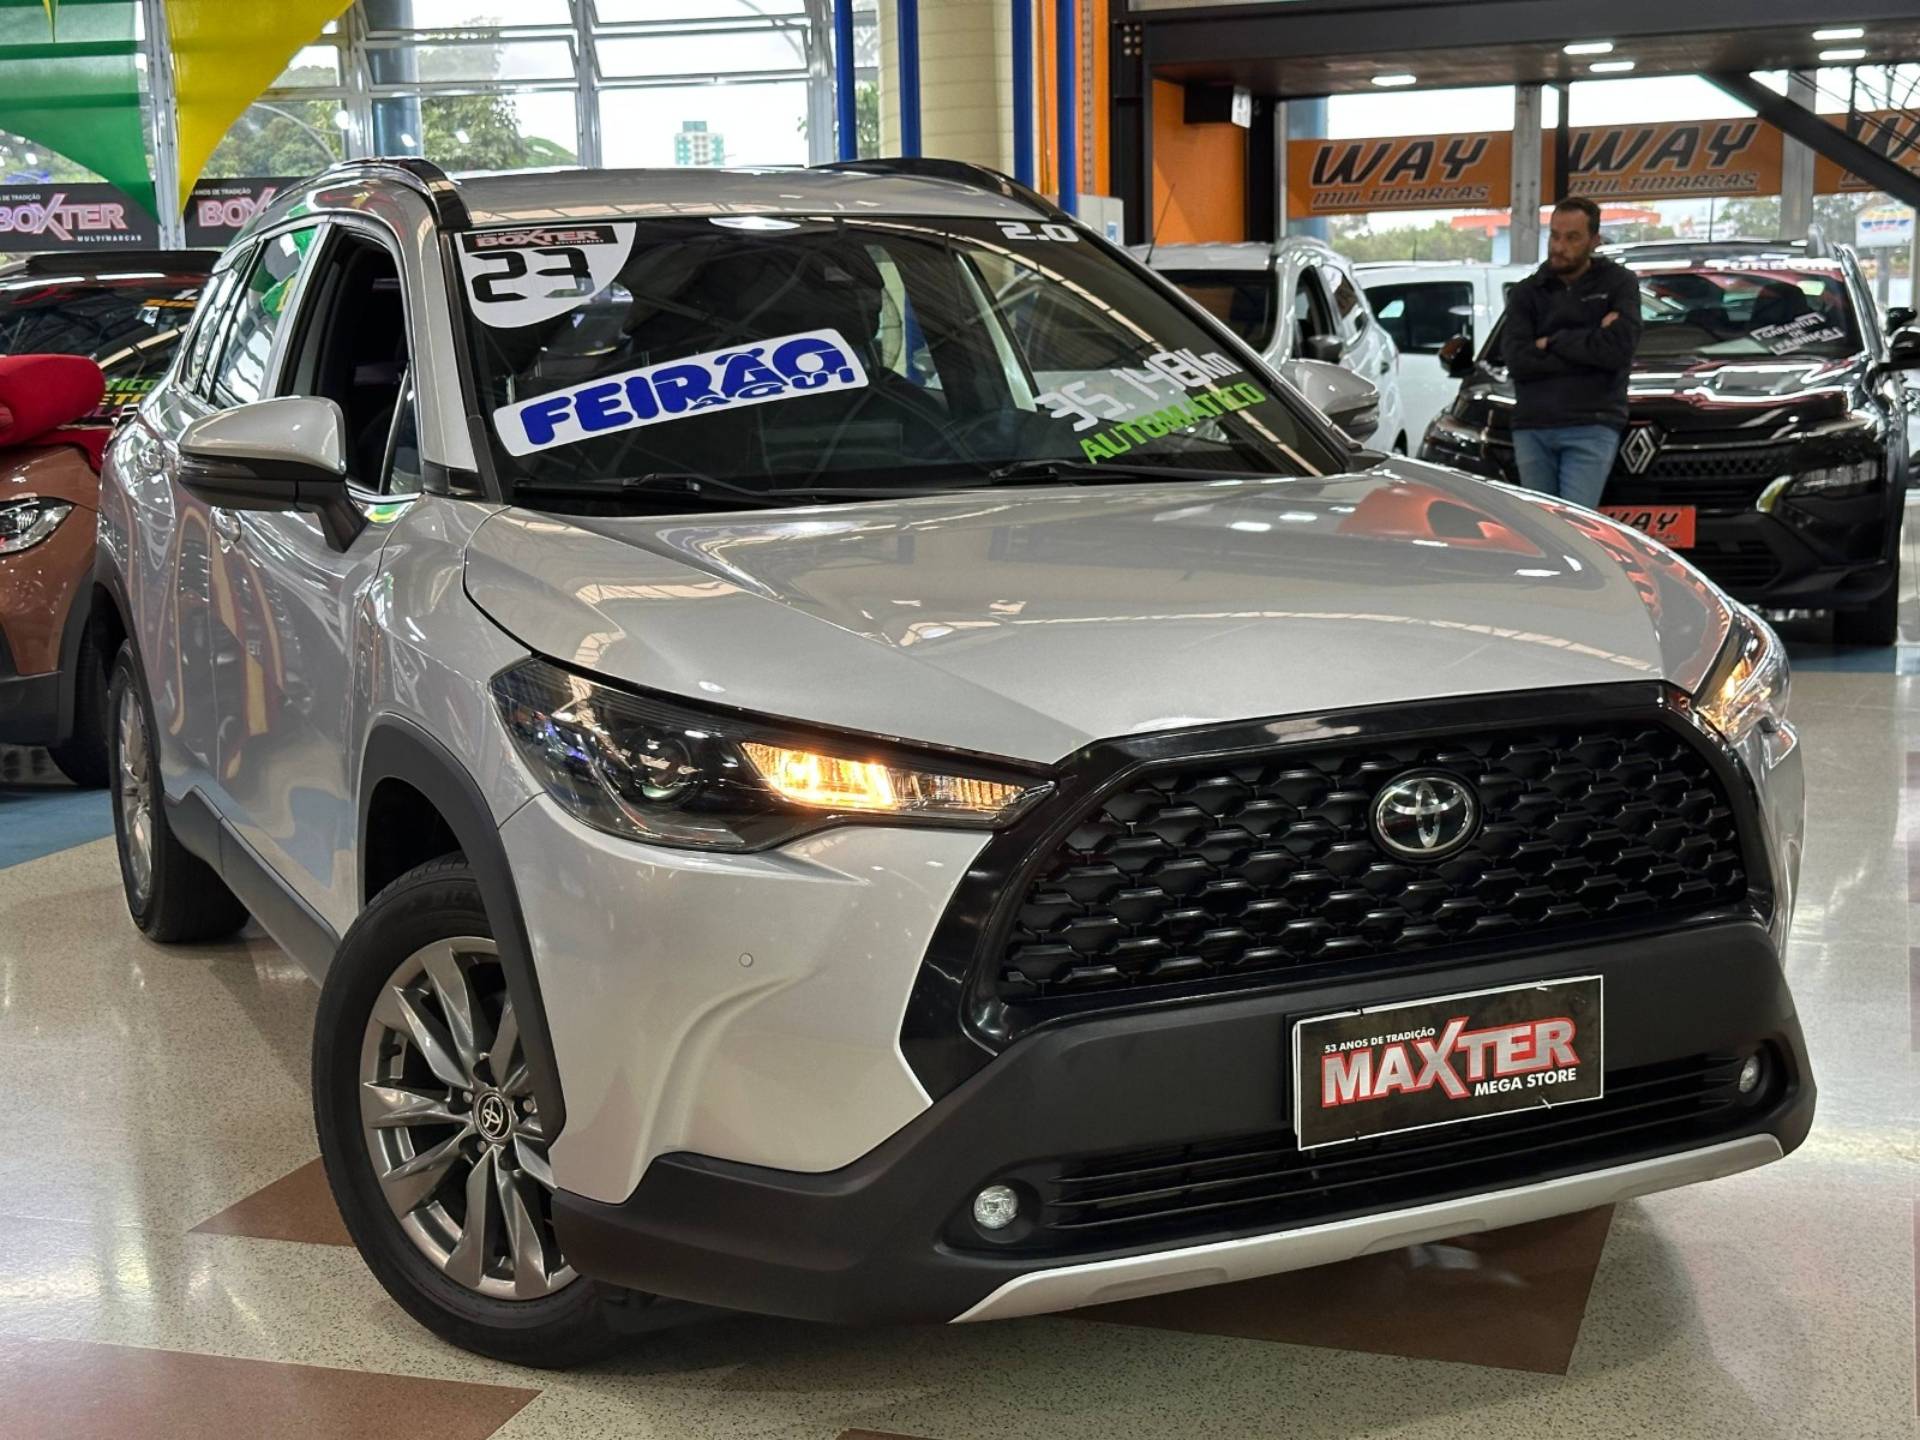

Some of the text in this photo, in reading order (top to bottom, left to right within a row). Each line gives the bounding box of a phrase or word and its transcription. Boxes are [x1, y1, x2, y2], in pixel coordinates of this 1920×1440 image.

[1311, 135, 1491, 187] WAY
[1568, 122, 1760, 175] WAY
[0, 192, 129, 242] BOXTER
[475, 228, 600, 248] BOXTER
[996, 221, 1079, 242] 2.0
[471, 246, 596, 304] 23
[520, 338, 849, 446] FEIRÃO
[1321, 1015, 1581, 1108] MAXTER
[1324, 1026, 1436, 1054] 53 ANOS DE TRADIÇÃO
[1474, 1067, 1577, 1098] MEGA STORE
